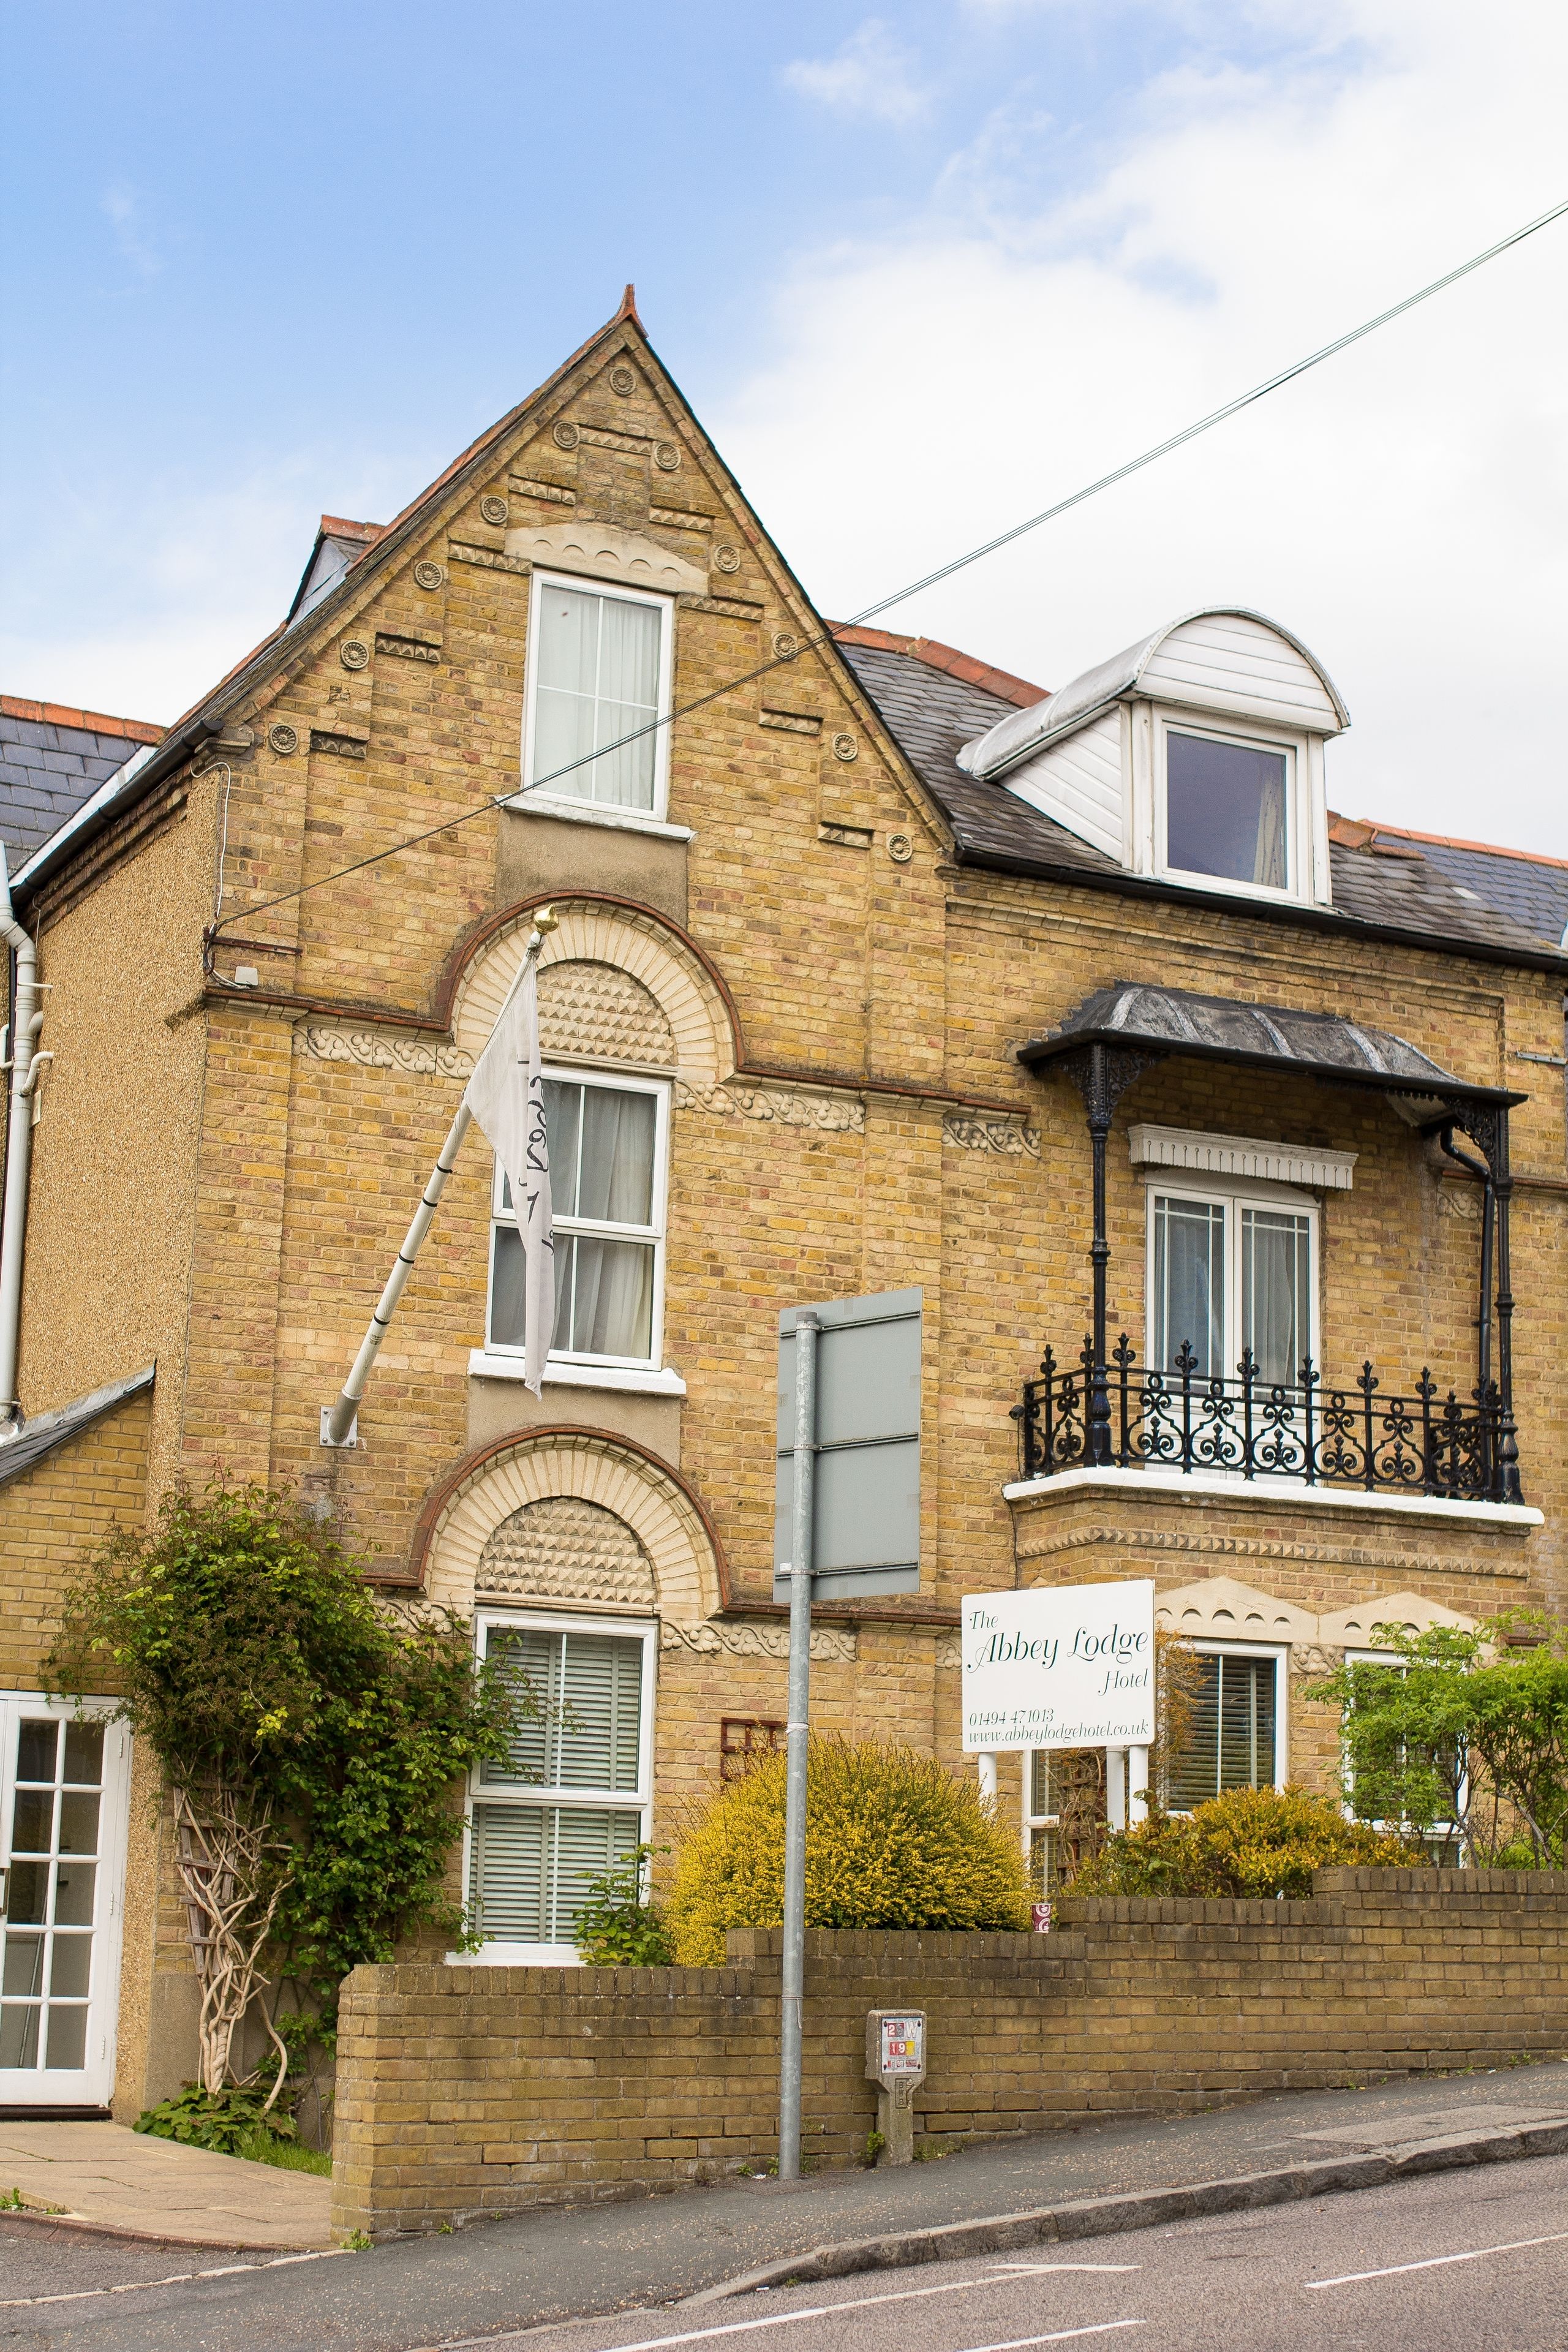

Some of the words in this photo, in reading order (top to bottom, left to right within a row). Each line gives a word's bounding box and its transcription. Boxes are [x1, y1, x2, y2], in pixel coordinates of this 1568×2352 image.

[969, 1610, 999, 1629] The
[966, 1631, 1059, 1673] Abbey
[1066, 1624, 1148, 1664] Lodge
[1098, 1668, 1148, 1697] Hotel
[970, 1711, 1006, 1726] 01494
[1009, 1708, 1054, 1724] 471013
[970, 1719, 1149, 1745] www.abbeylodgehotel.co.uk
